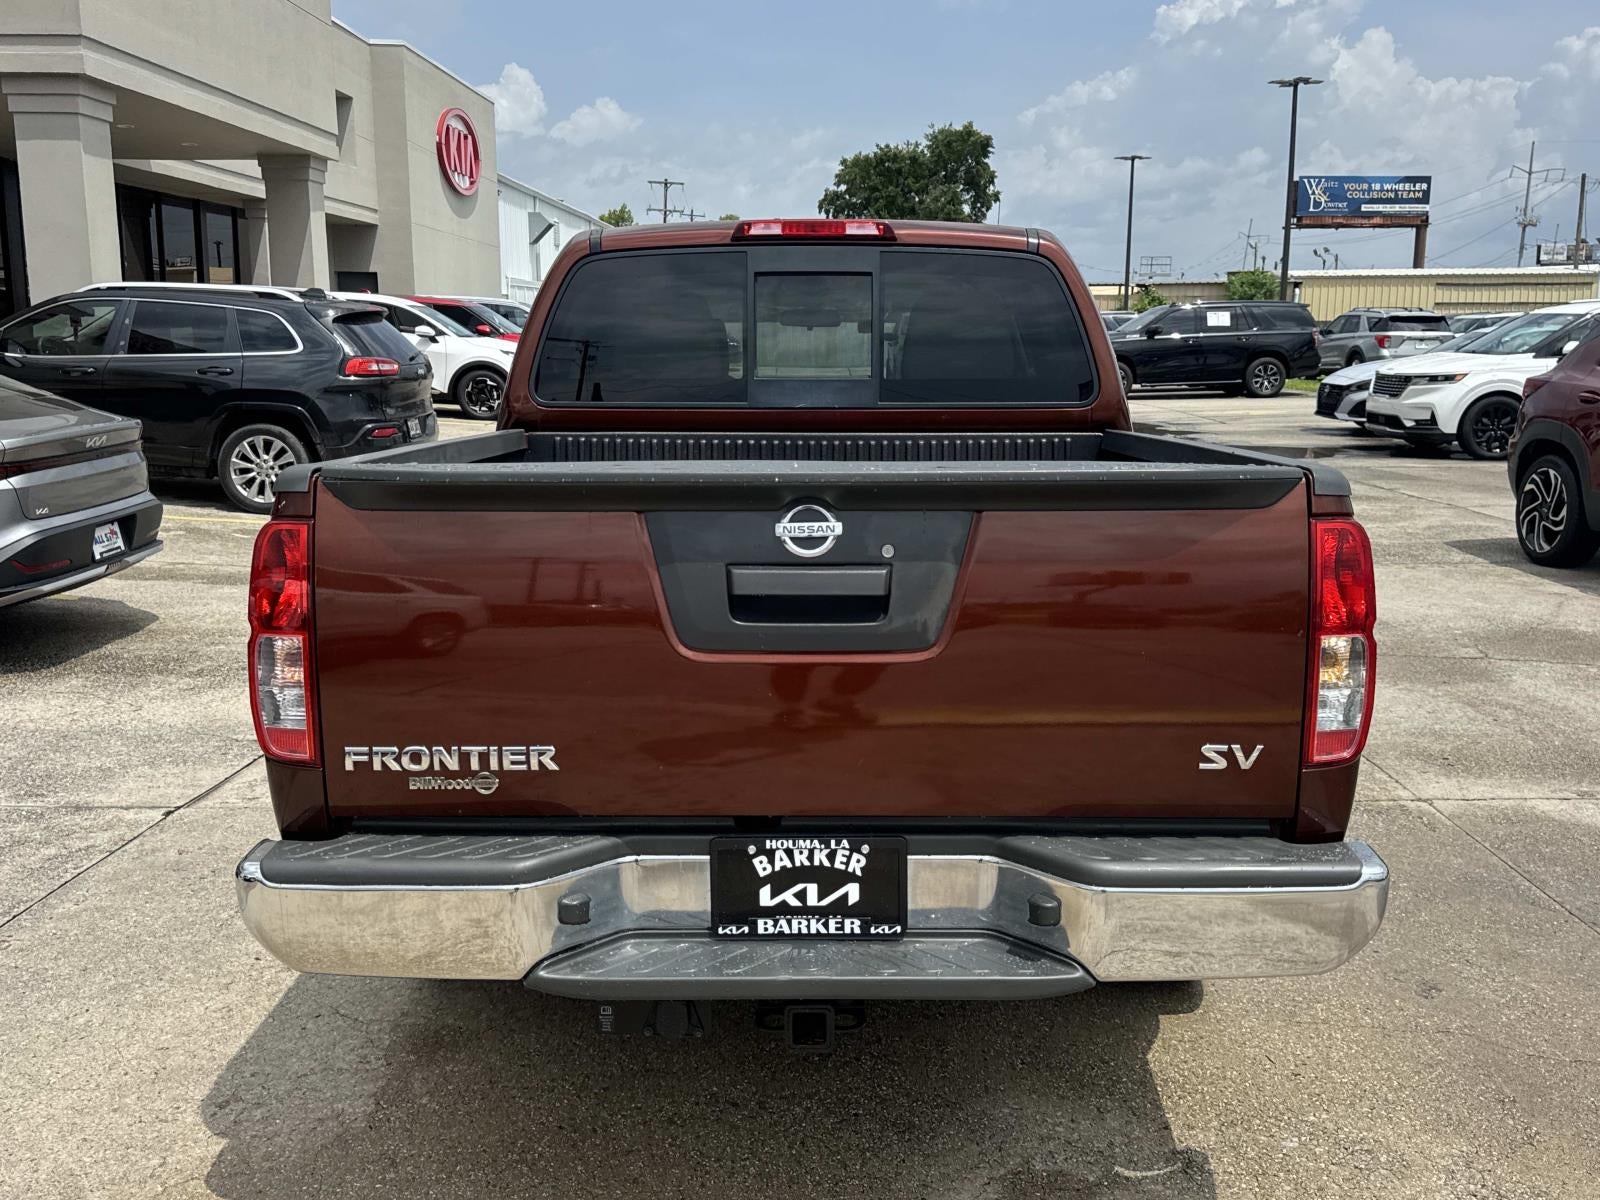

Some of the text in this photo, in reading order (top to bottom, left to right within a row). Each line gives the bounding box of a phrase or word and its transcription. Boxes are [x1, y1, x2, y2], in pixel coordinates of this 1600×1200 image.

[448, 124, 477, 180] KIA
[1344, 183, 1428, 191] YOUR 18 WHEELER
[1347, 191, 1423, 199] COLLISION TEAM
[783, 525, 835, 534] NISSAN
[344, 745, 560, 772] FRONTIER
[1199, 744, 1264, 770] SV
[765, 839, 850, 850] HOUMA, LA
[752, 848, 867, 878] BARKER
[759, 882, 860, 907] KIA
[718, 925, 749, 935] KIA
[757, 918, 861, 934] BARKER
[870, 924, 902, 934] KIA
